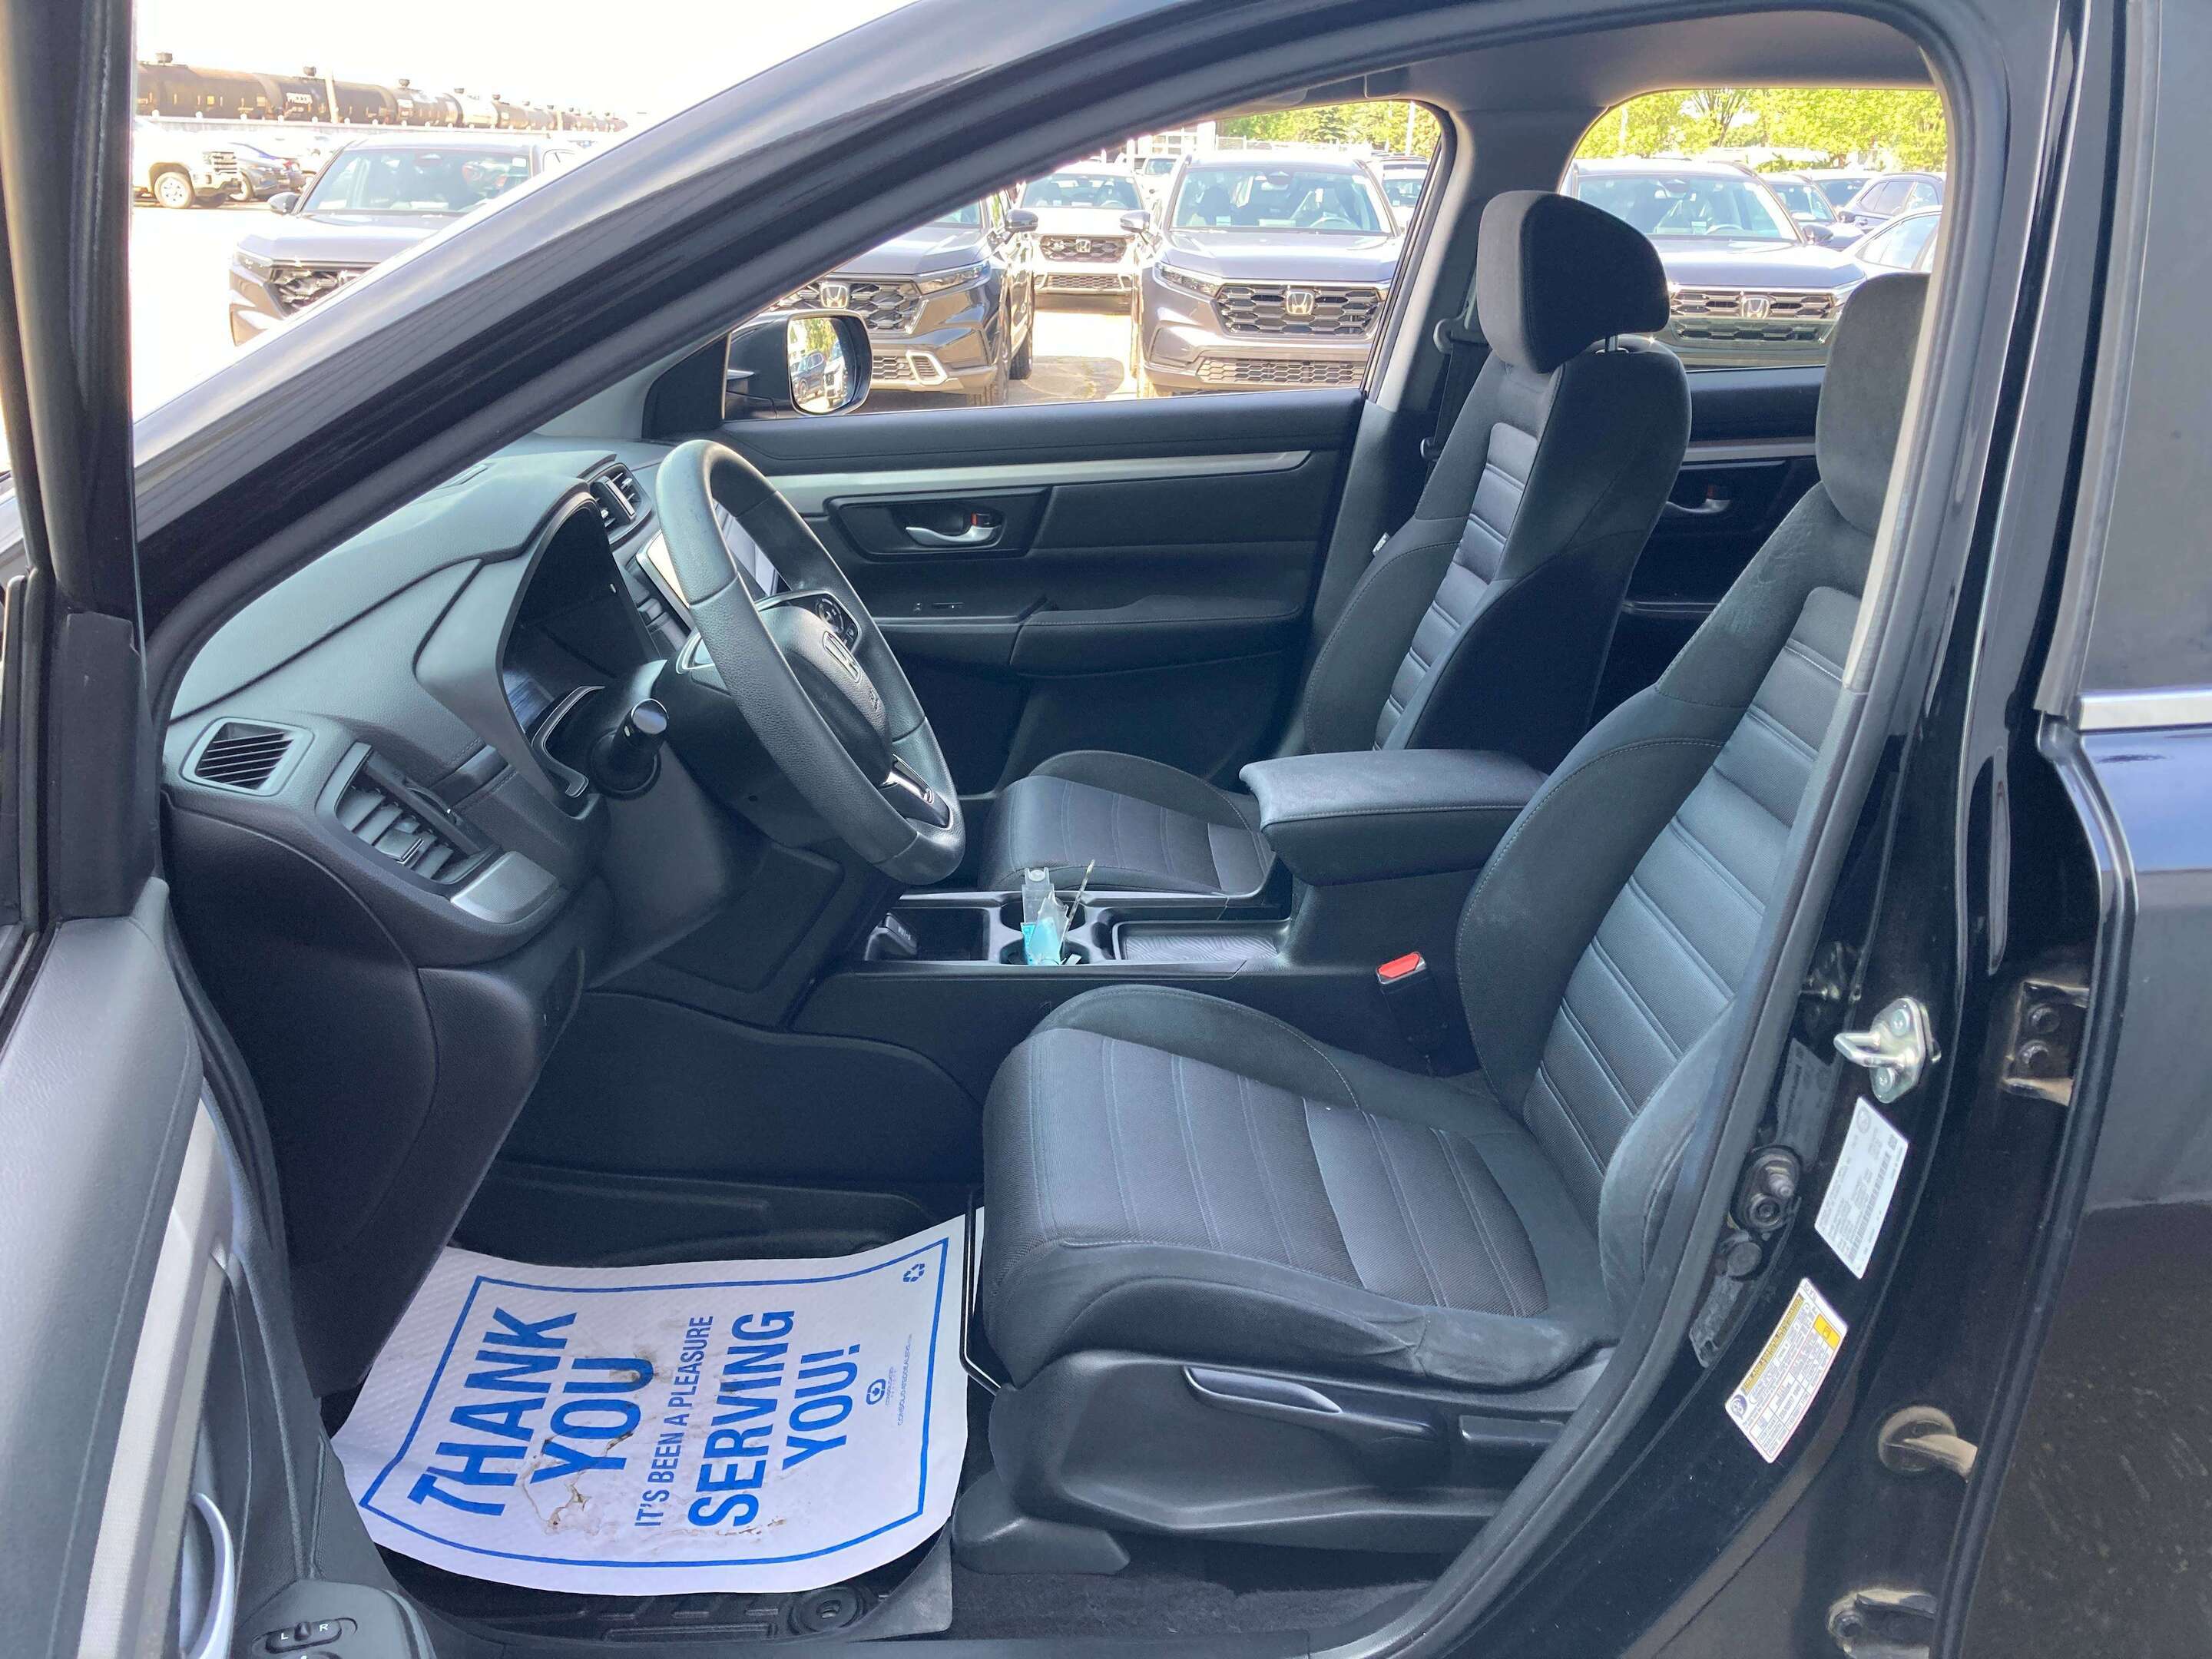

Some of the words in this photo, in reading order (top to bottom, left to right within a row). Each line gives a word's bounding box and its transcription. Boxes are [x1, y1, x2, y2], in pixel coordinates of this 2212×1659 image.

[667, 1316, 713, 1408] PLEASURE
[782, 1344, 860, 1471] YOU!
[406, 1309, 576, 1518] THANK
[528, 1357, 654, 1485] YOU
[647, 1432, 685, 1483] BEEN
[664, 1413, 690, 1426] A
[687, 1310, 794, 1528] SERVING
[634, 1489, 671, 1527] IT'S
[281, 1632, 288, 1641] L
[320, 1623, 329, 1631] R
